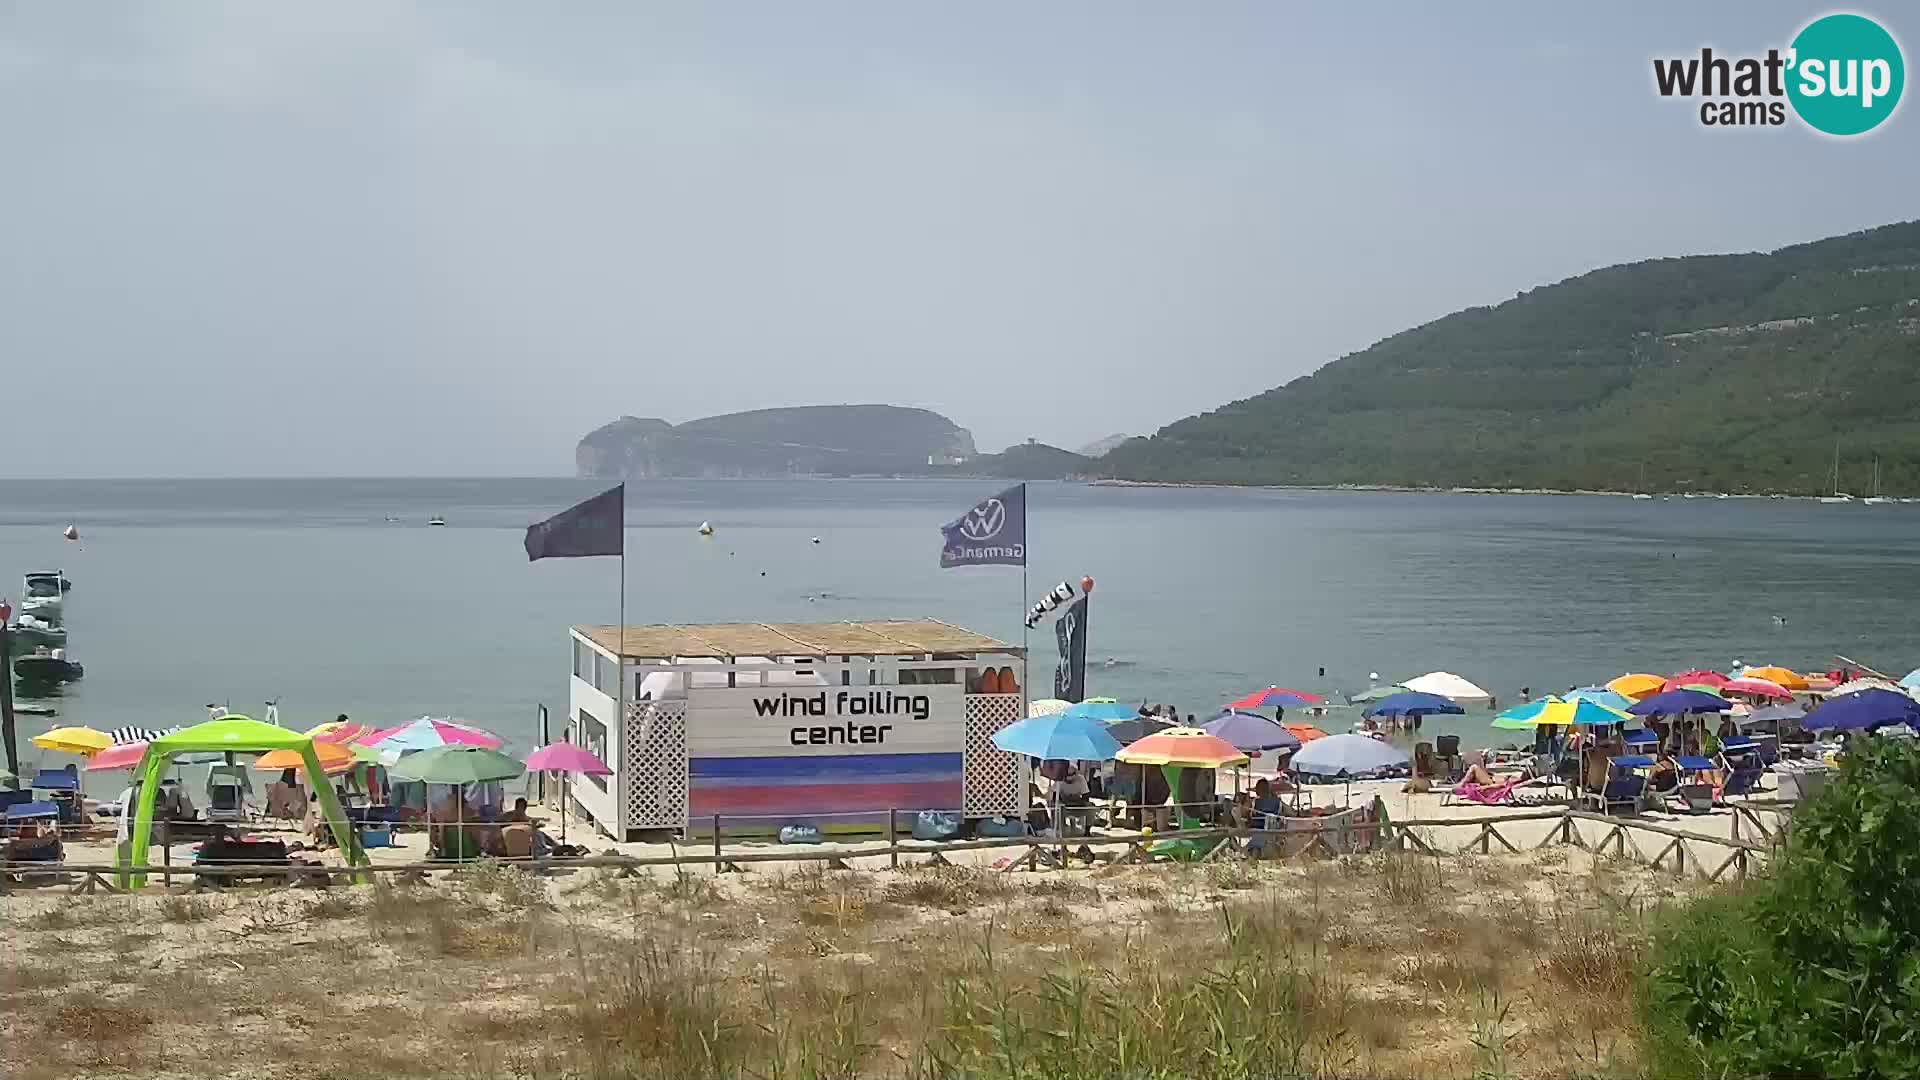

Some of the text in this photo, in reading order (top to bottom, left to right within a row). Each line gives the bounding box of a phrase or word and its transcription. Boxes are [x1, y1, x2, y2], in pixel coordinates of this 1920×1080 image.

[753, 691, 930, 720] wind foiling
[791, 721, 893, 746] center
